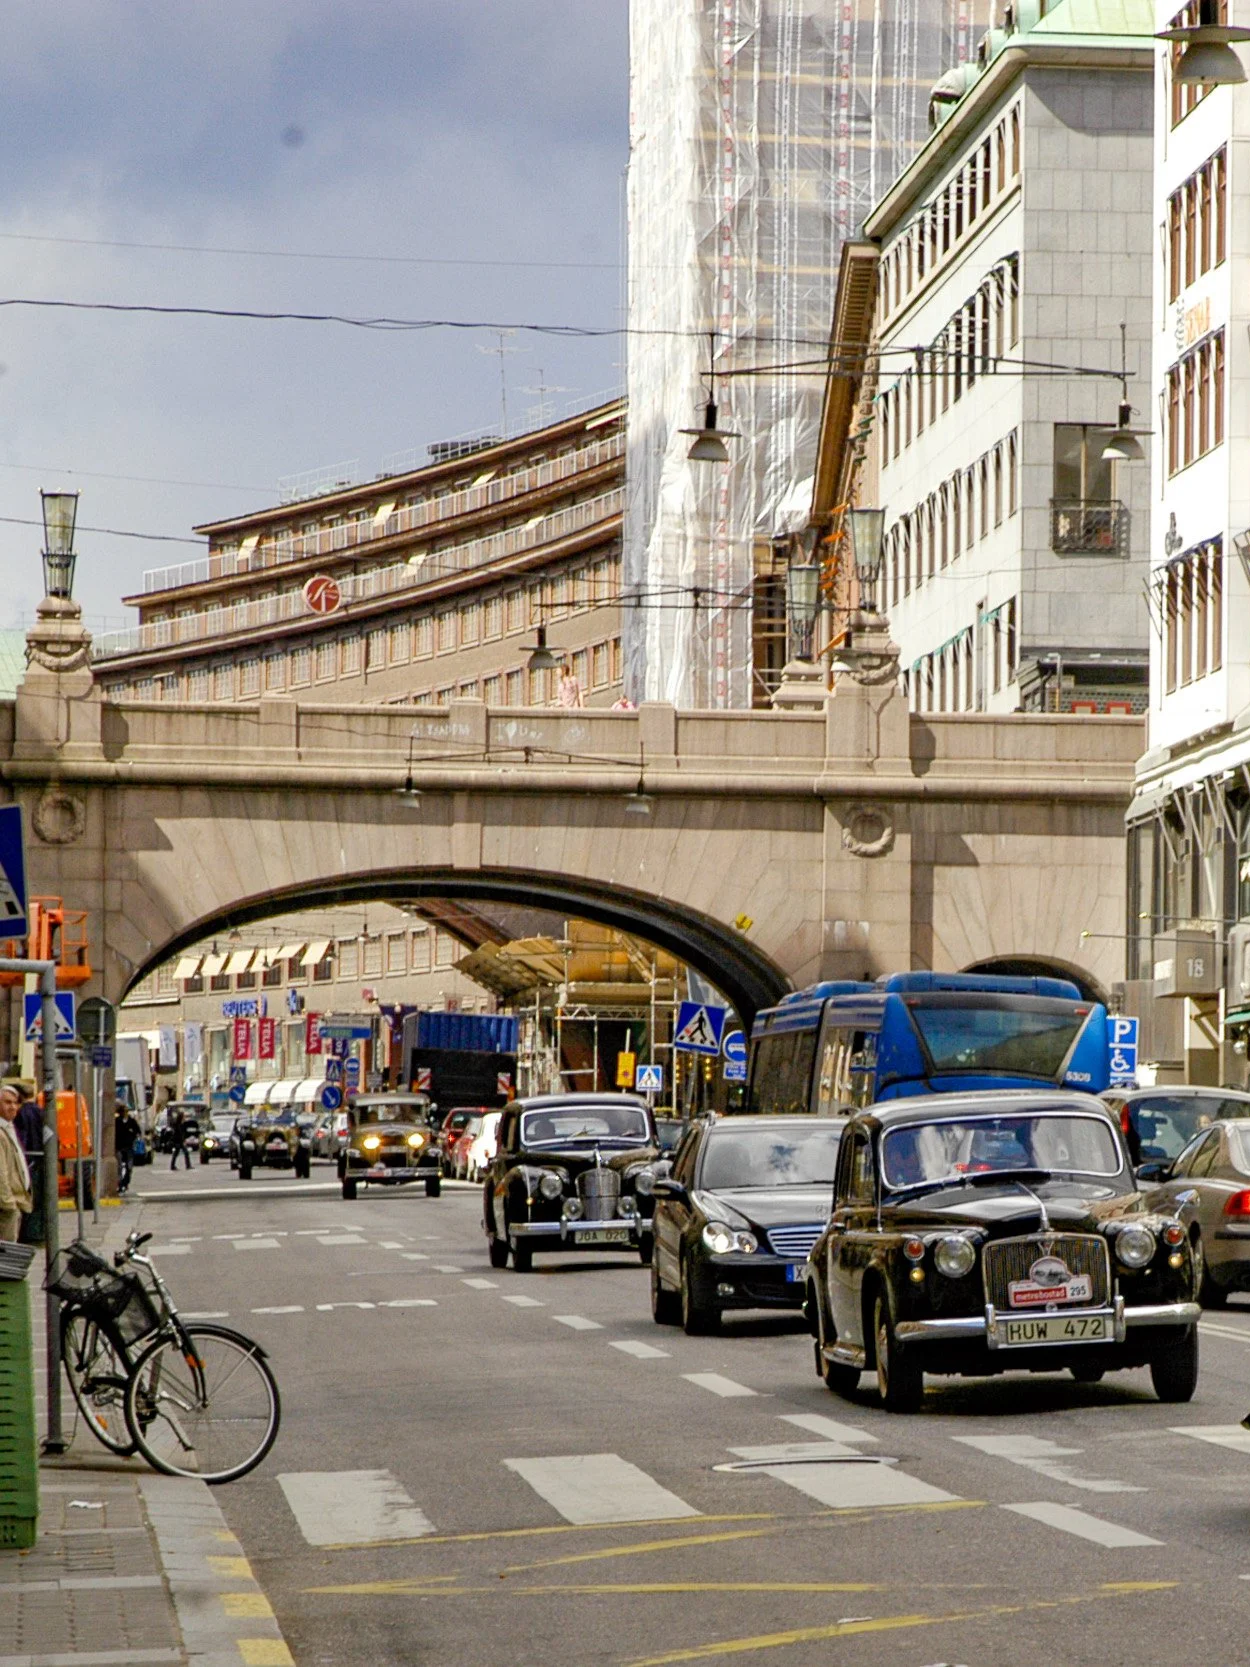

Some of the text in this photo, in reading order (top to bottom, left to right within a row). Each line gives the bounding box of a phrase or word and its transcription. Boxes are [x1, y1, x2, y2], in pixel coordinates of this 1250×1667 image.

[1187, 959, 1204, 978] 18
[1114, 1020, 1132, 1043] P
[1070, 1285, 1087, 1297] 295
[1010, 1318, 1102, 1340] HUW 472
